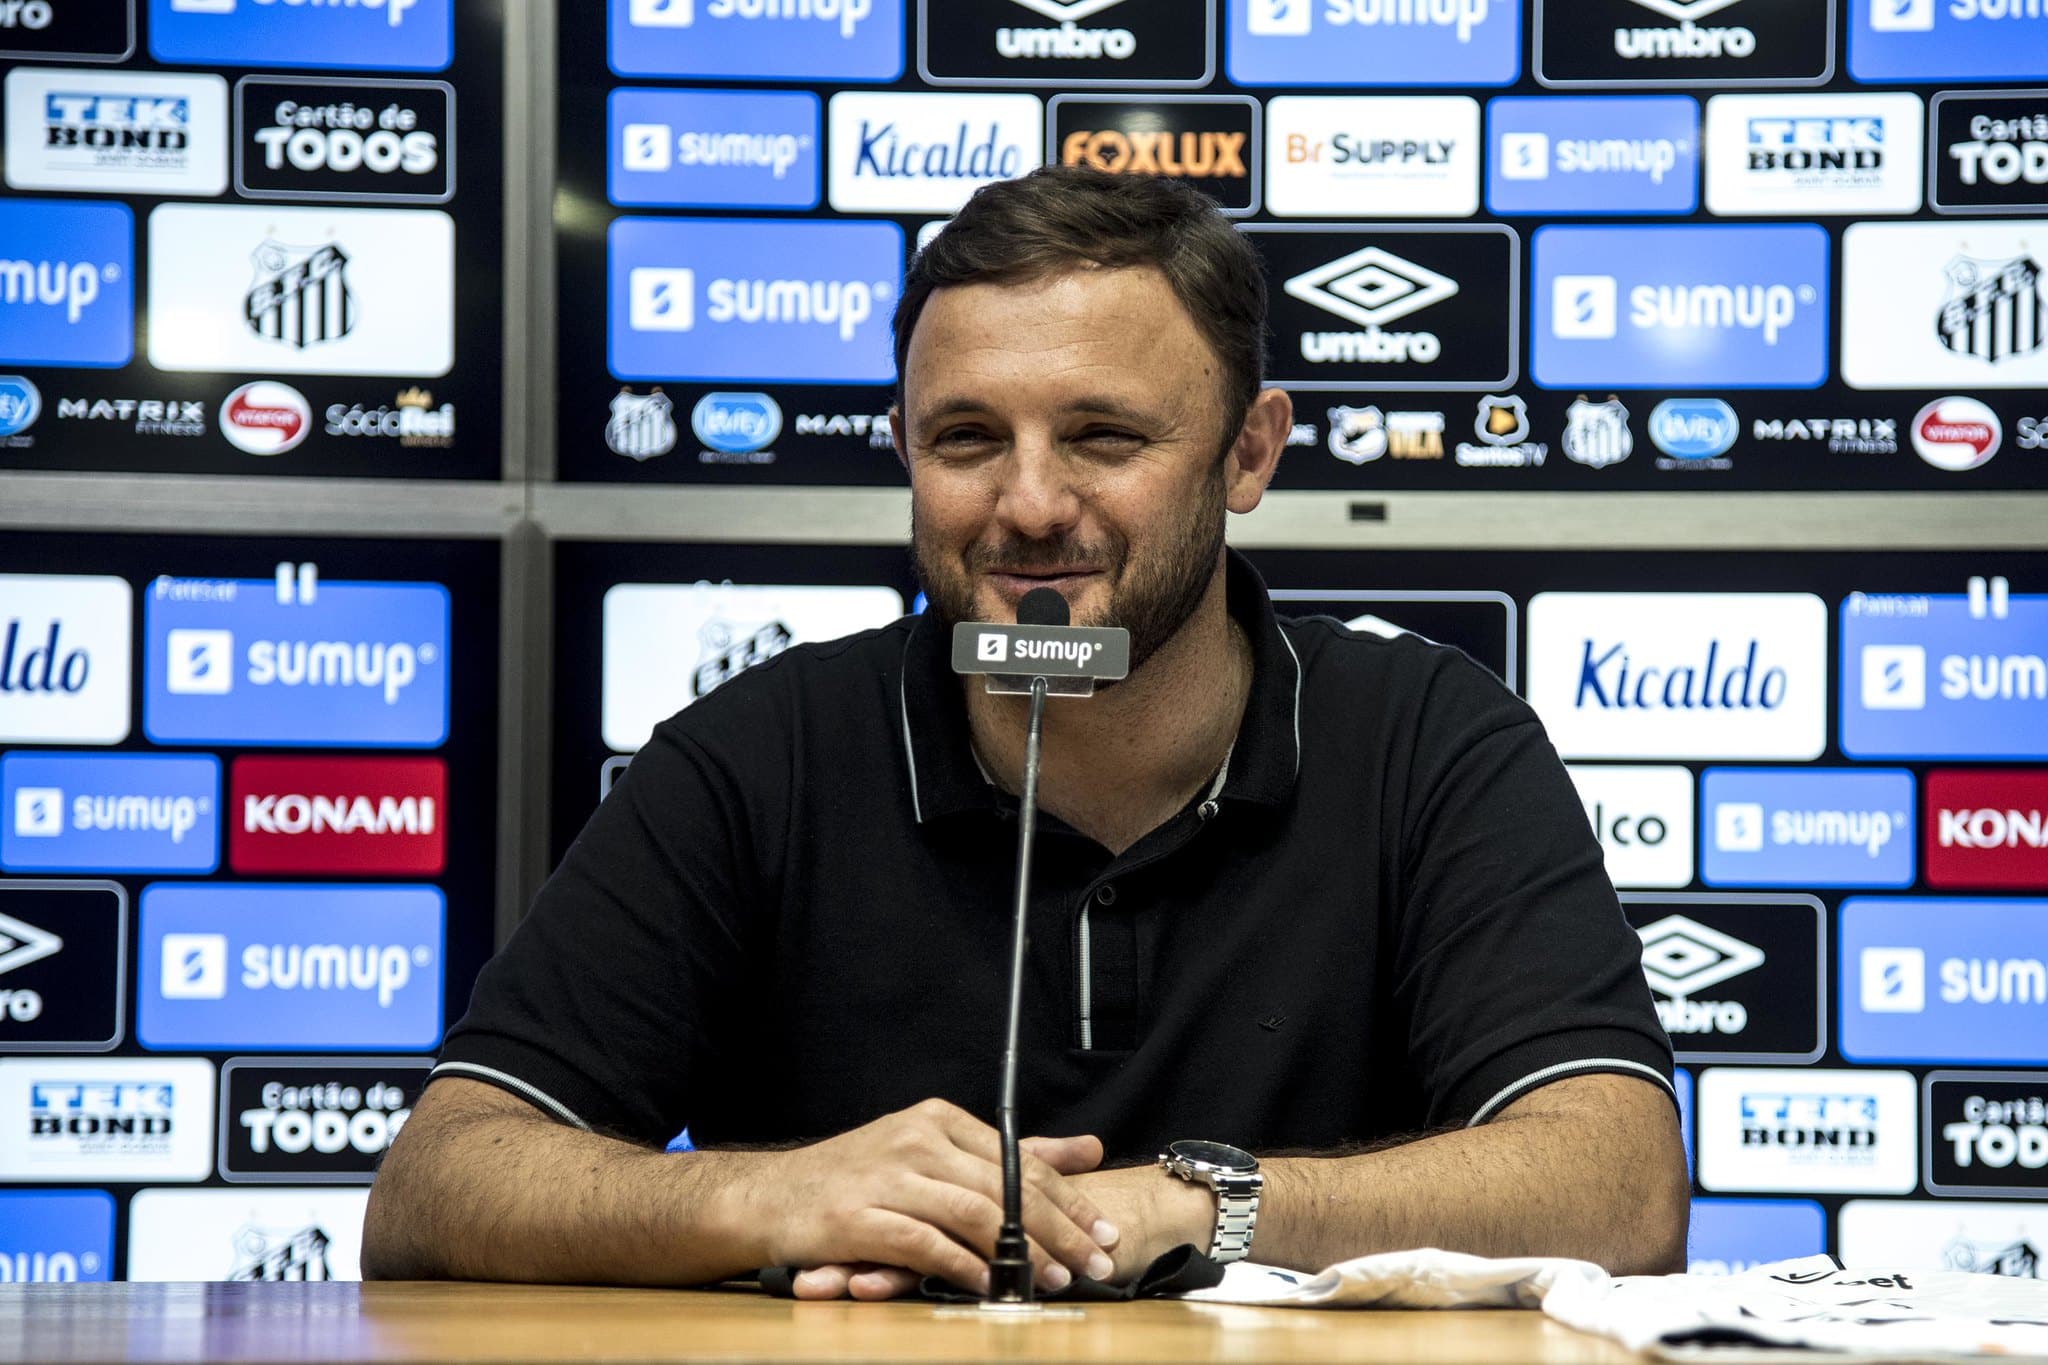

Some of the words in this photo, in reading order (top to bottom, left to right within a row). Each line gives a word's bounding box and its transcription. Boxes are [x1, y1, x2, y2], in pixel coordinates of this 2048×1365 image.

[996, 23, 1136, 60] umbro
[1614, 21, 1756, 58] umbro
[46, 93, 188, 125] TEK
[378, 104, 418, 131] de
[46, 127, 188, 150] BOND
[1746, 117, 1885, 145] TEK
[255, 127, 438, 174] TODOS
[854, 119, 1021, 178] Kicaldo
[1063, 130, 1246, 178] FOXLUX
[1332, 132, 1456, 164] SUPPLY
[1746, 147, 1883, 171] BOND
[1301, 327, 1441, 363] umbro
[57, 398, 205, 421] MATRIX
[1753, 418, 1897, 440] MATRIX
[1575, 638, 1787, 710] Kicaldo
[243, 794, 436, 835] KONAMI
[1938, 808, 2048, 848] KON
[365, 1081, 405, 1110] de
[31, 1114, 173, 1137] BOND
[1741, 1127, 1877, 1148] BOND
